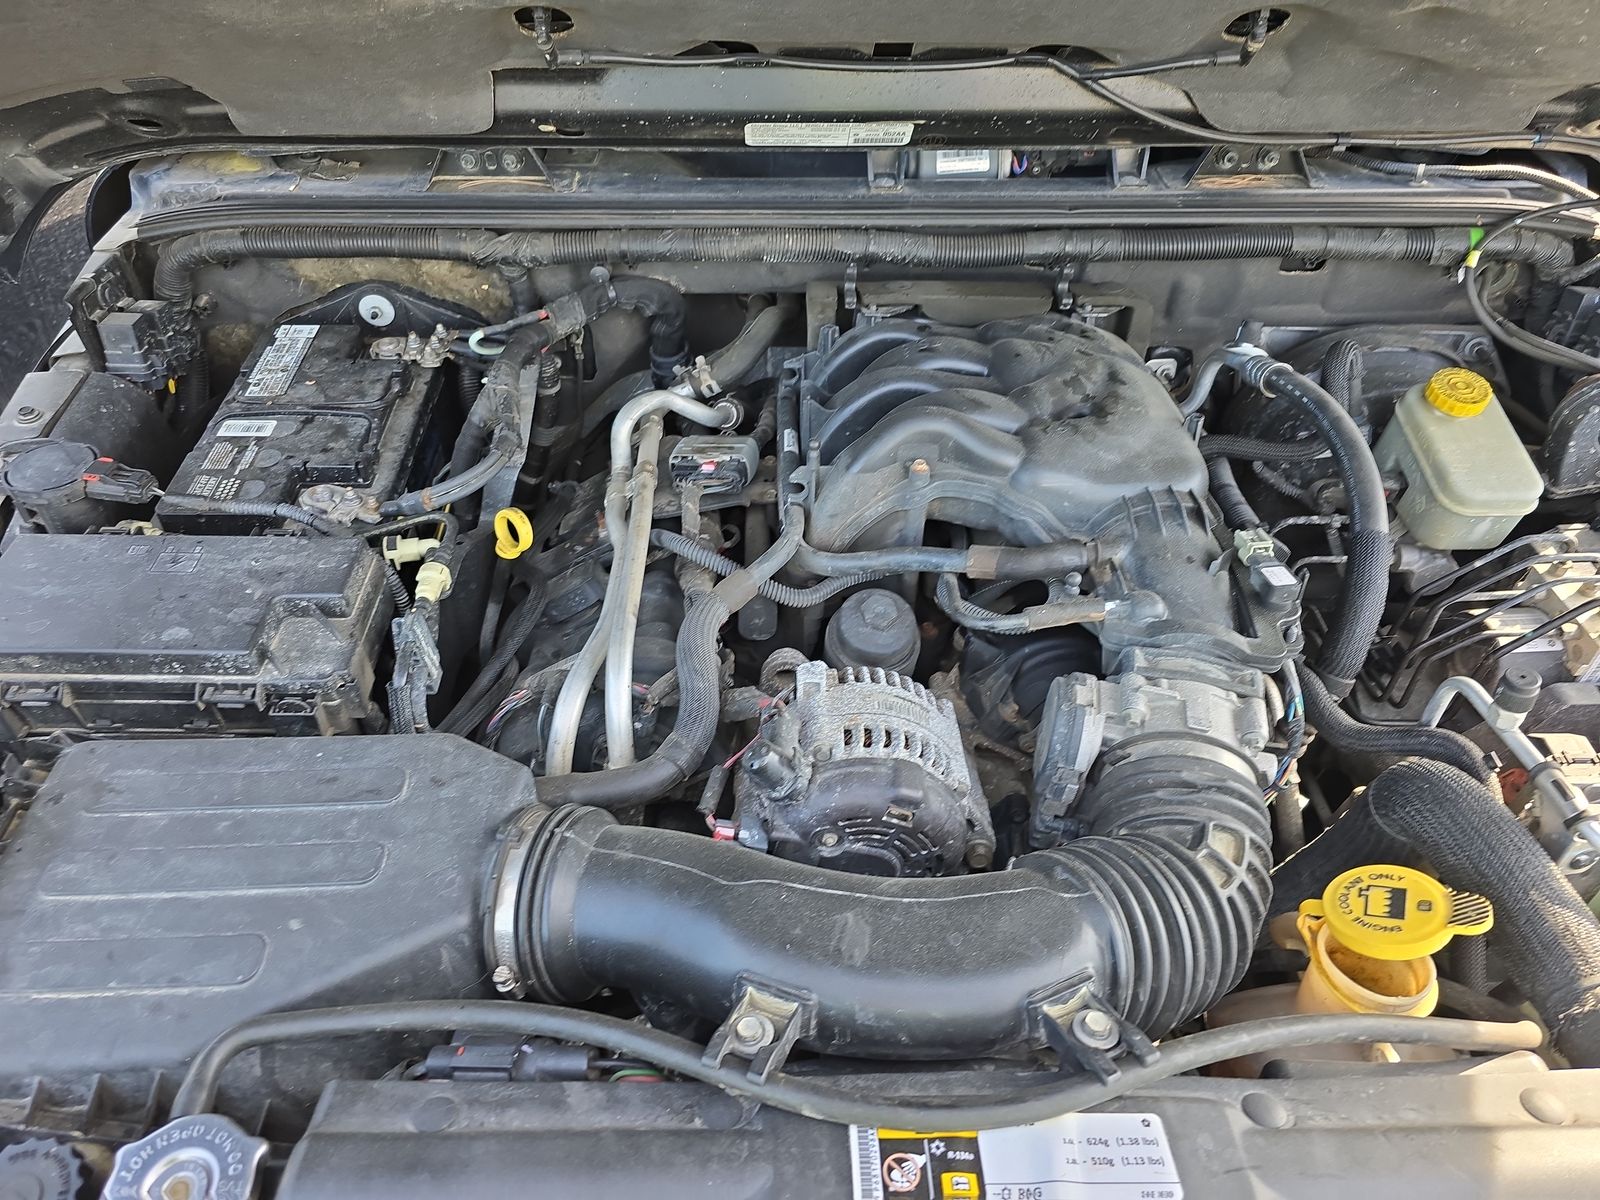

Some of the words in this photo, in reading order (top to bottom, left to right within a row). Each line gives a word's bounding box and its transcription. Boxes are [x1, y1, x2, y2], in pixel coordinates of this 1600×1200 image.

[1368, 873, 1406, 882] ONLY
[1337, 876, 1364, 915] COOLANT
[1351, 916, 1403, 932] ENGINE
[155, 1124, 206, 1150] OPEN
[119, 1146, 154, 1183] HOT
